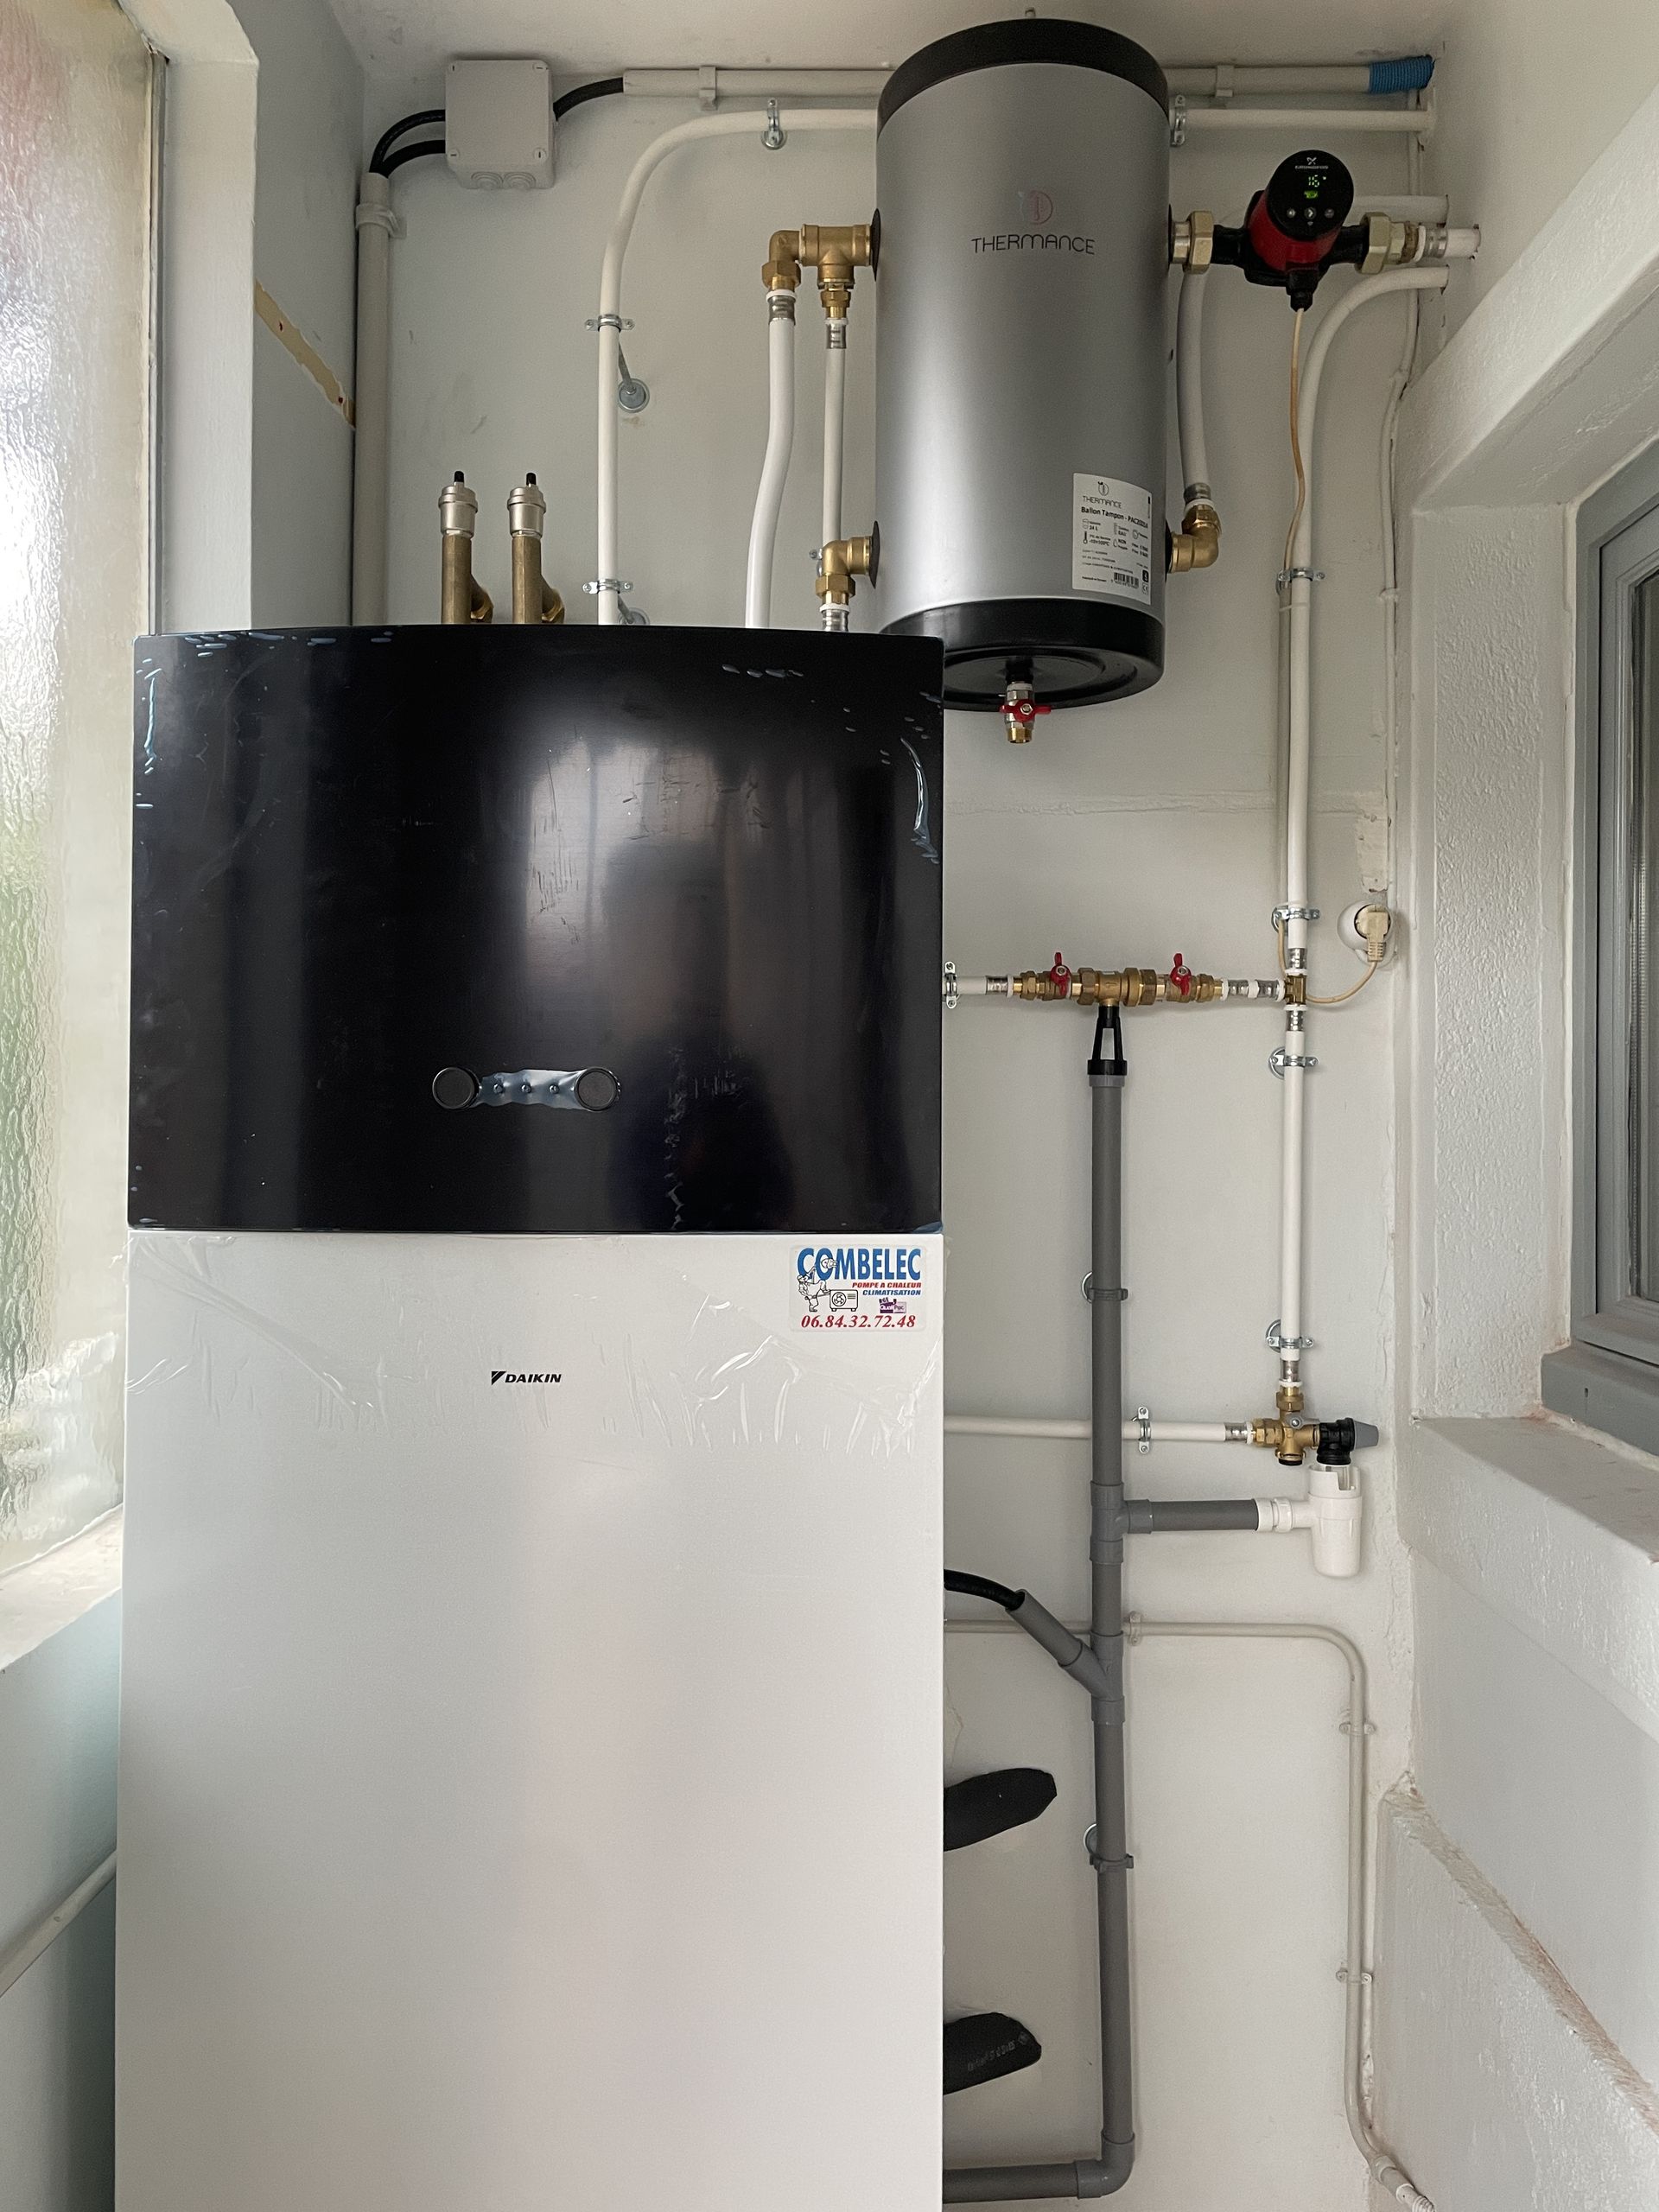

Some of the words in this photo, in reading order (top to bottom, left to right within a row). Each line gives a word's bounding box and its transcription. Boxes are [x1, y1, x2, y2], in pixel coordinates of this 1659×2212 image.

[970, 233, 1096, 255] THERMANCE
[1082, 495, 1122, 509] THERMANCE
[1081, 506, 1101, 516] Ballon
[1102, 507, 1124, 520] Tampon
[798, 1248, 921, 1281] COMBELEC
[801, 1314, 916, 1328] 06.84.32.72.48
[505, 1374, 562, 1383] DAIKIN
